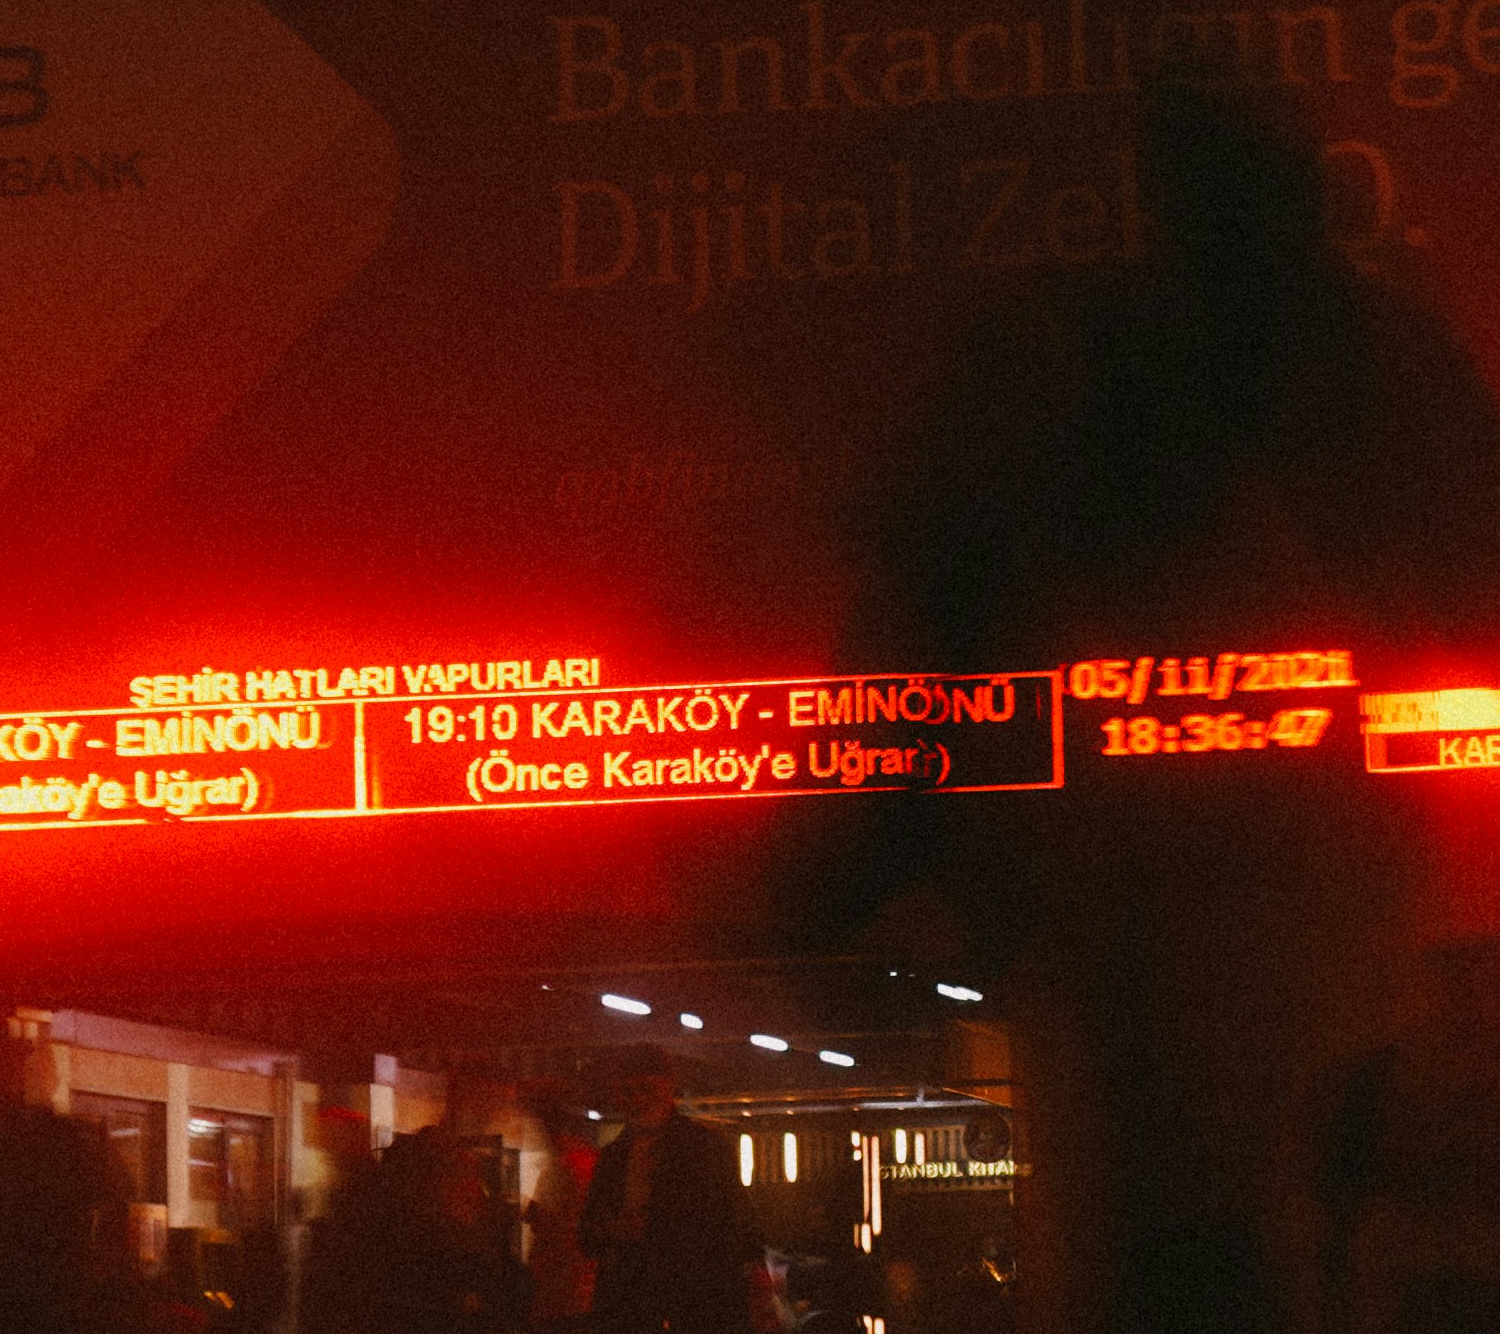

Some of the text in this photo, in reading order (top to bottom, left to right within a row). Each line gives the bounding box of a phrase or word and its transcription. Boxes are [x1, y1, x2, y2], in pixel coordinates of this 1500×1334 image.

[550, 147, 918, 312] Dijital
[244, 665, 395, 701] HATLARI
[402, 658, 600, 694] VAPURLARI
[1068, 649, 1358, 705] 05/11/2021
[115, 707, 326, 757] EMİNÖNÜ
[403, 702, 518, 744] 19:10
[530, 688, 751, 740] KARAKÖY
[787, 676, 1017, 728] EMİNÖNÜ
[1100, 707, 1332, 756] 18:36:47
[134, 766, 259, 816] Uğrar)
[465, 749, 590, 801] (Önce
[602, 744, 796, 794] Karaköy'e
[878, 1161, 964, 1180] STANBUL
